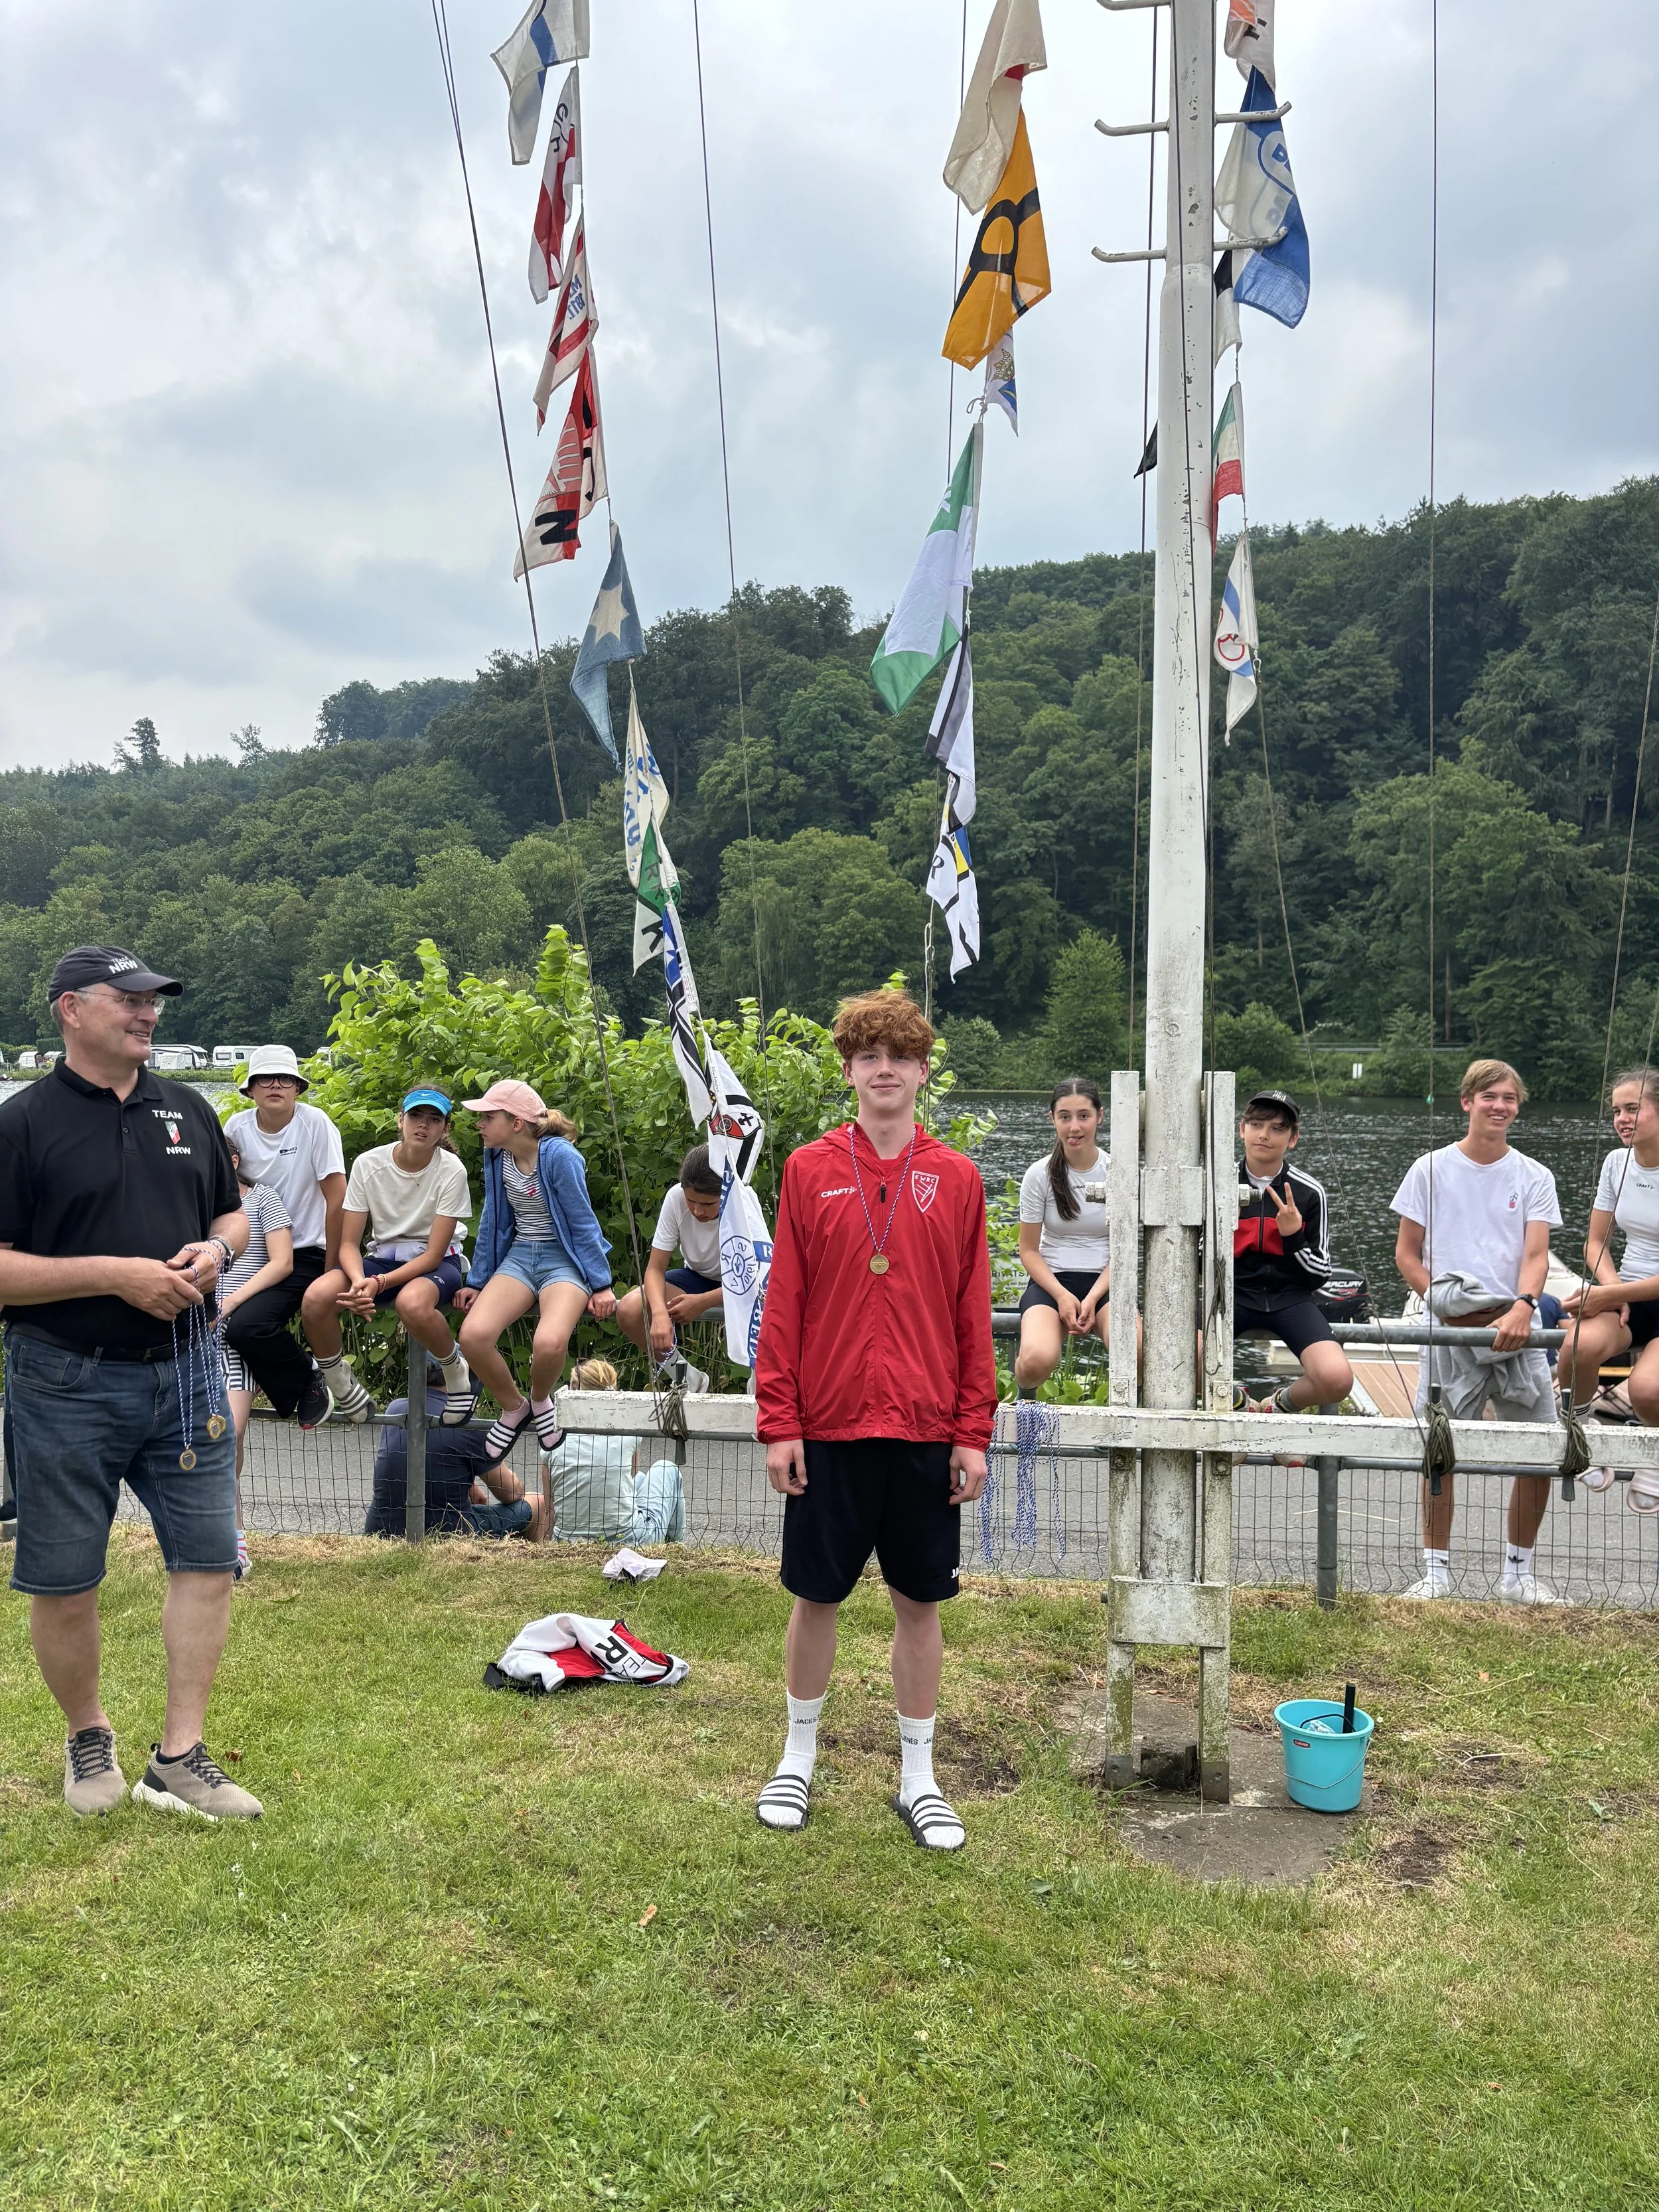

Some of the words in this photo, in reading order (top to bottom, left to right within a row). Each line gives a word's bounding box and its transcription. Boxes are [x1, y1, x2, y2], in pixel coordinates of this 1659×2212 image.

[108, 960, 138, 974] NRW
[151, 1110, 183, 1120] TEAM
[165, 1146, 191, 1155] NRW
[914, 1174, 936, 1184] EWRC
[821, 1187, 849, 1198] CRAFT
